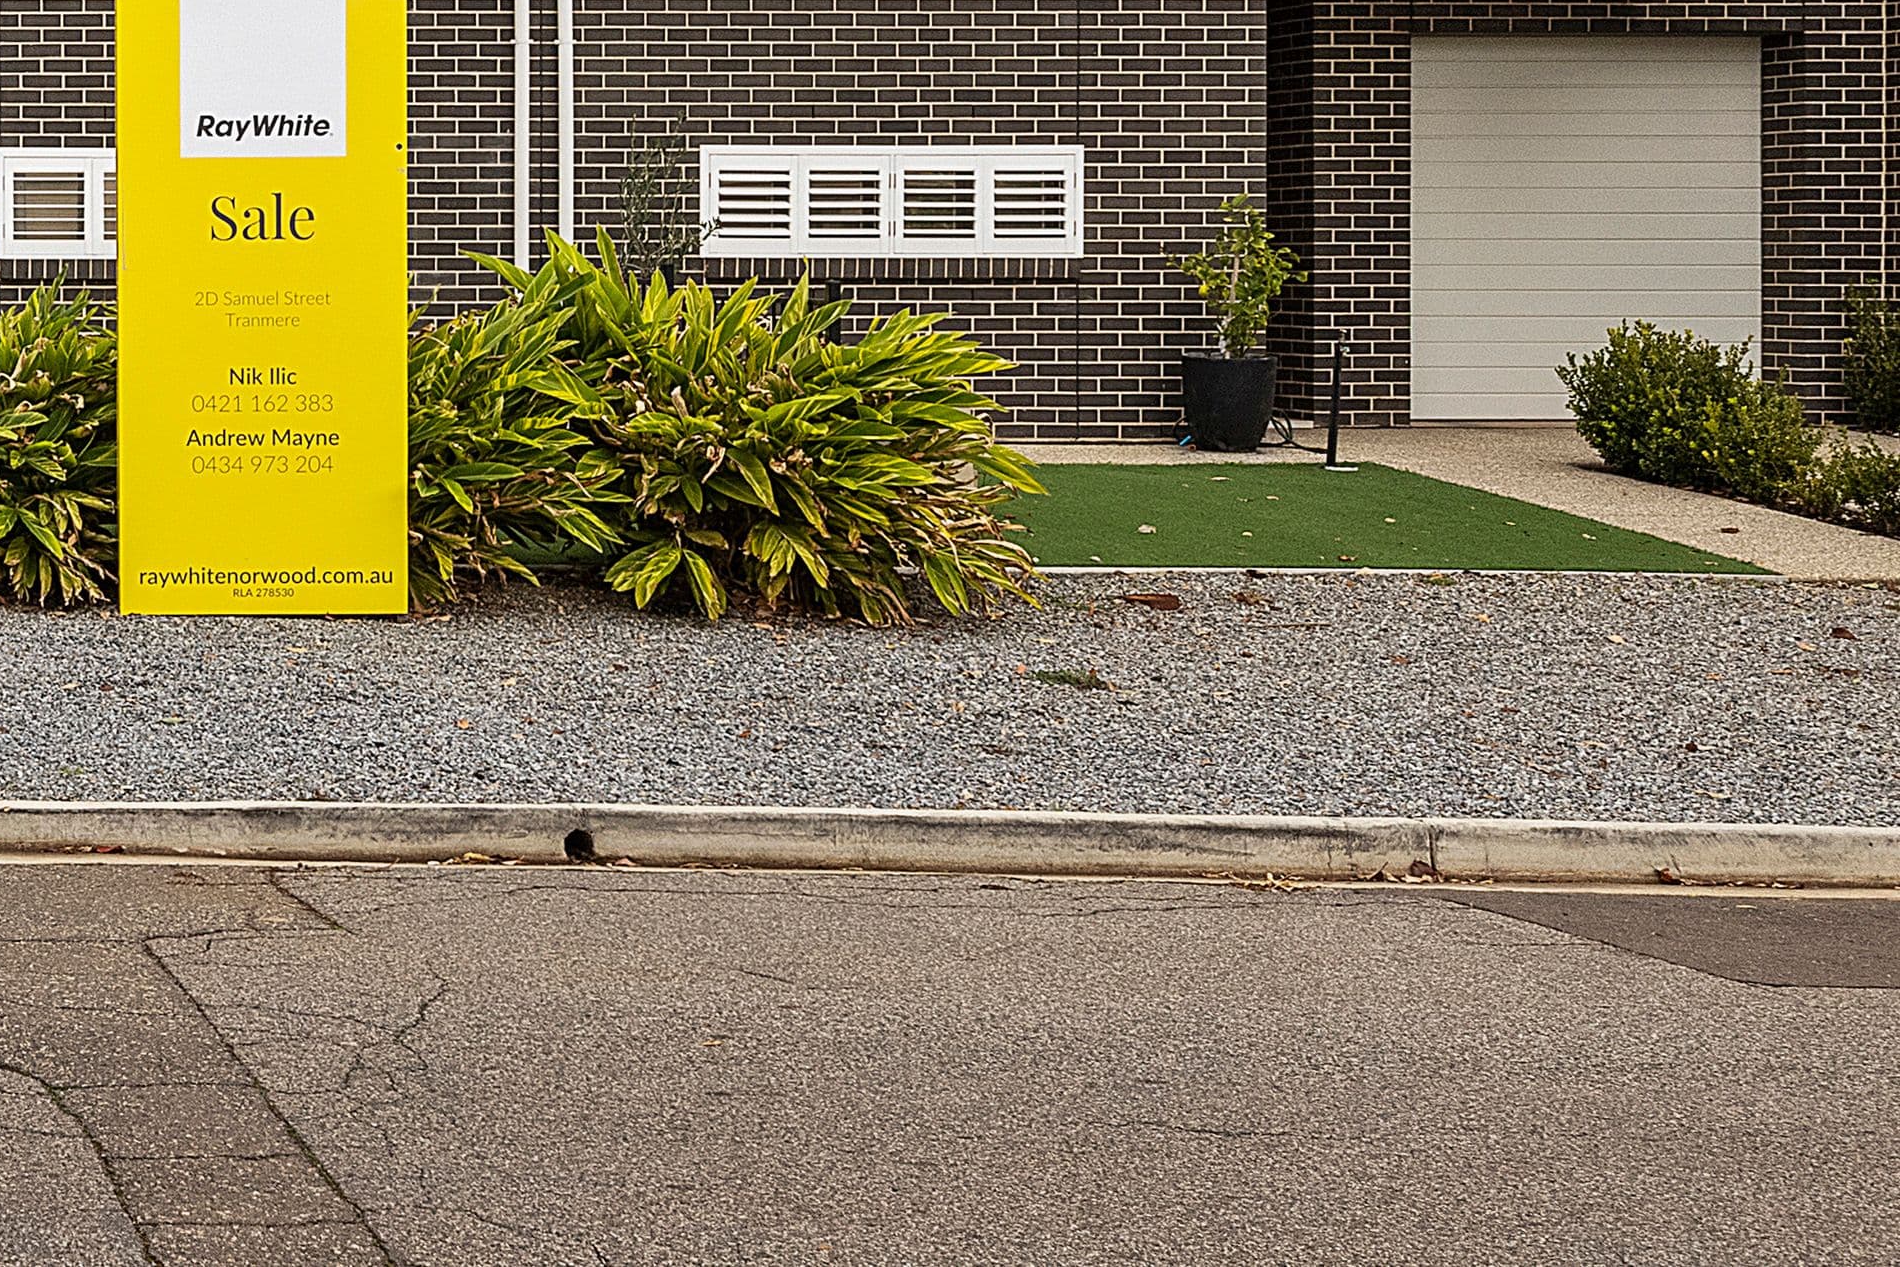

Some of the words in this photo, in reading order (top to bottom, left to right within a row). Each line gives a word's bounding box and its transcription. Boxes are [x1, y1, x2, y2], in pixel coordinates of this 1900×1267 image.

[211, 192, 315, 242] Sale
[195, 291, 219, 307] 2D
[223, 290, 279, 307] Samuel
[283, 290, 331, 306] Street
[224, 312, 301, 328] Tranmere
[229, 367, 263, 386] Nik
[269, 366, 297, 386] Ilic
[191, 394, 243, 413] 0421
[251, 394, 289, 413] 162
[295, 393, 334, 413] 383
[185, 428, 265, 447] Andrew
[271, 428, 340, 450] Mayne
[191, 455, 244, 474] 0434
[250, 455, 289, 474] 973
[295, 455, 334, 474] 204
[139, 566, 394, 589] raywhitenorwood.com.au
[232, 588, 254, 598] RLA
[255, 588, 295, 598] 278530
